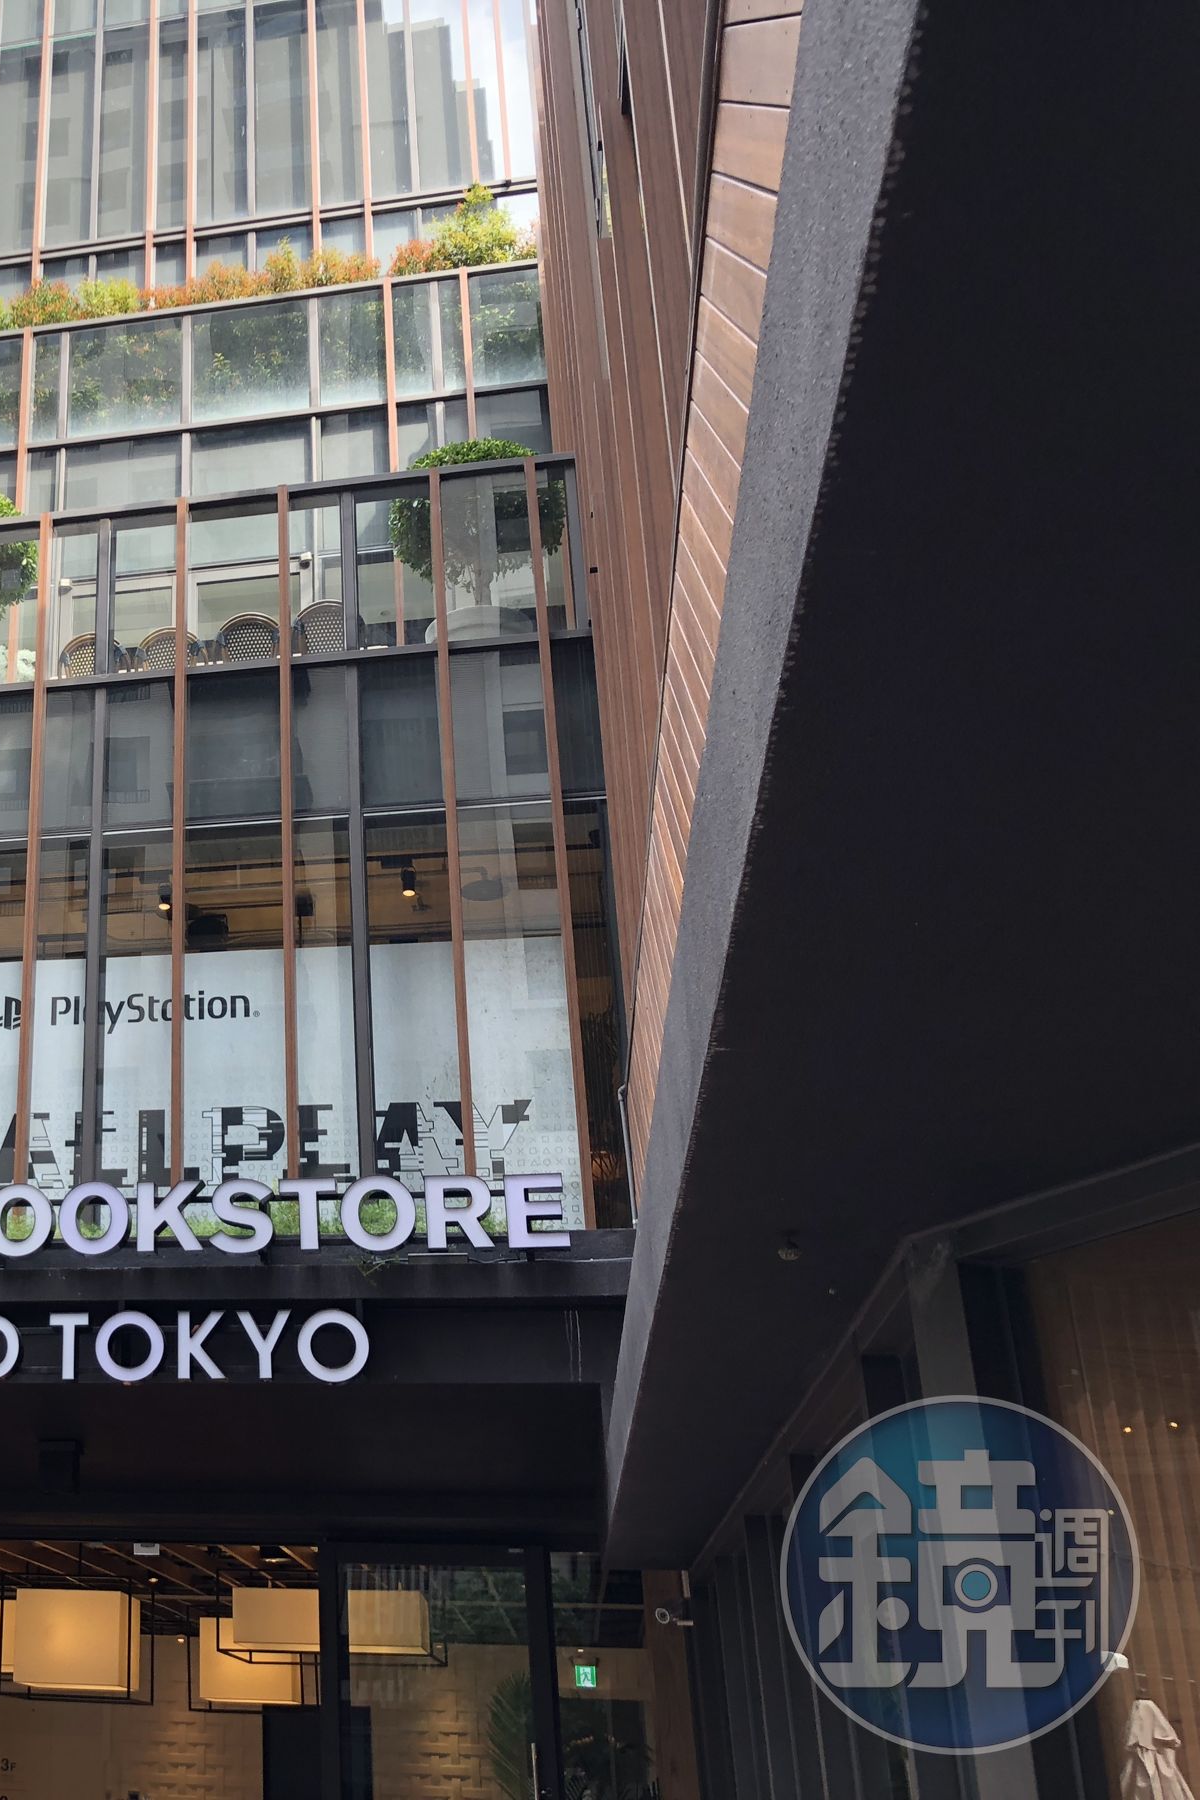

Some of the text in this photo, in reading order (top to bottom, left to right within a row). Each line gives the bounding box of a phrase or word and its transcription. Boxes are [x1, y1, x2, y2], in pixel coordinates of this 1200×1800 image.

[50, 990, 252, 1034] PlyStation
[50, 1310, 370, 1384] TOKYO
[0, 1757, 17, 1772] 3F
